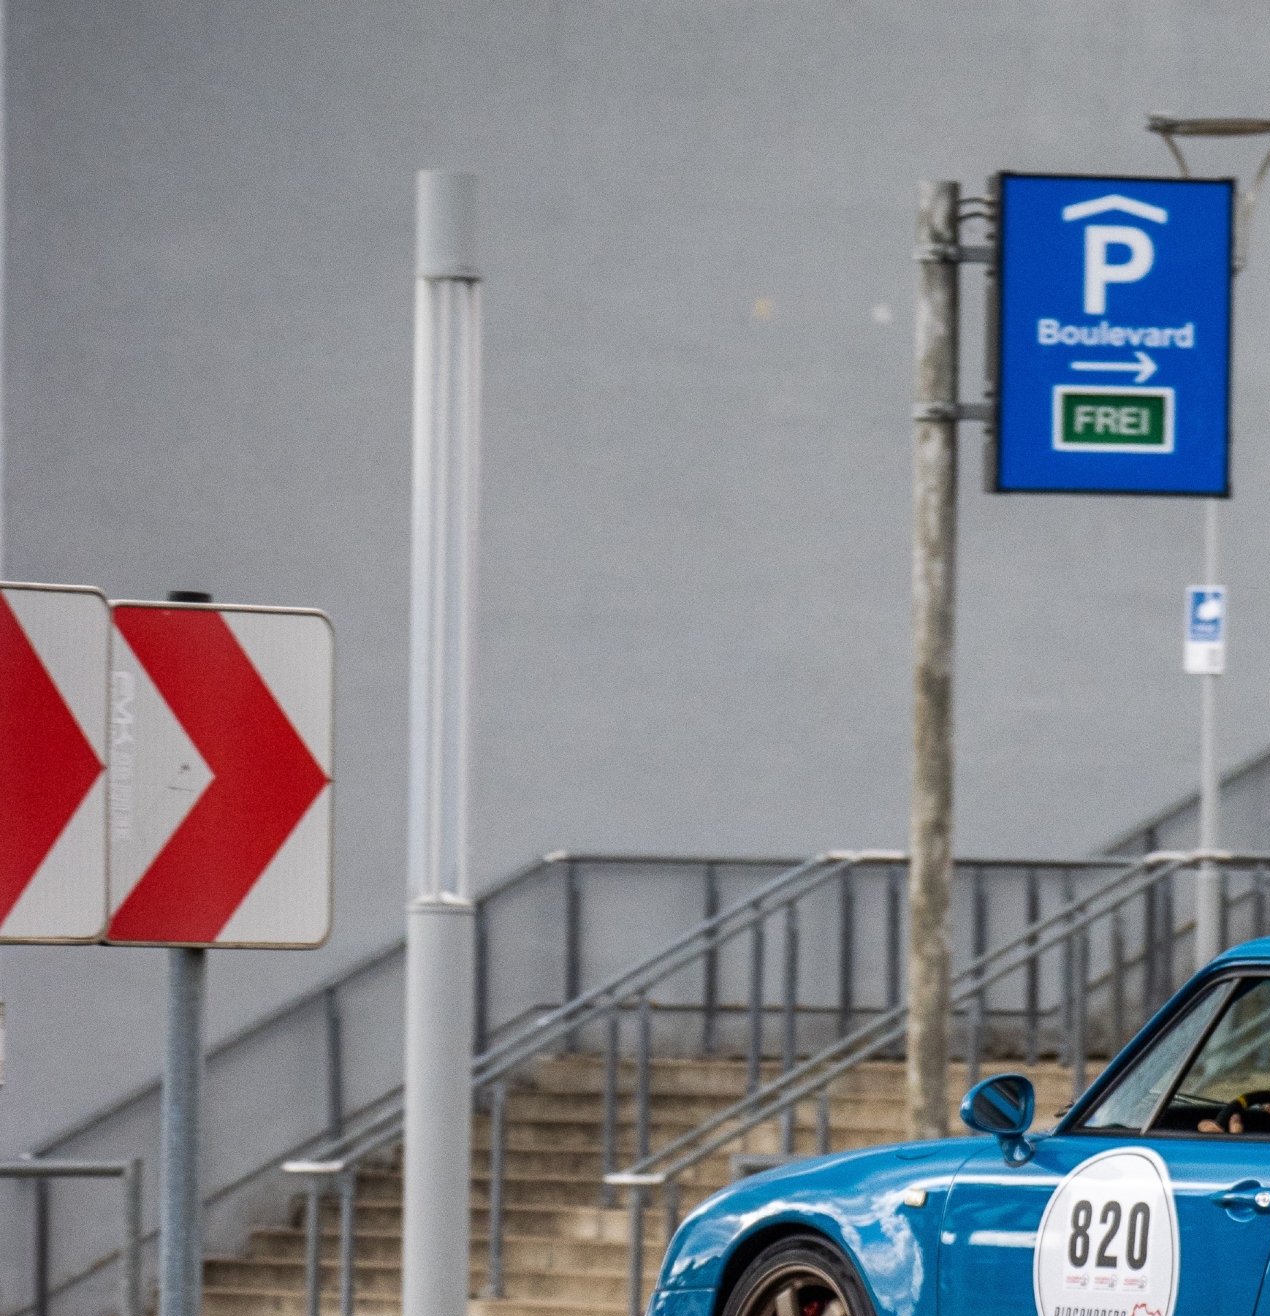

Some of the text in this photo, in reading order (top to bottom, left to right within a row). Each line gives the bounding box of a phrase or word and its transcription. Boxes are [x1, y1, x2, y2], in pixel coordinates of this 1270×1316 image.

[1084, 225, 1154, 314] P
[1038, 319, 1194, 347] Boulevard
[1073, 406, 1150, 435] FREI
[1068, 1200, 1151, 1270] 820
